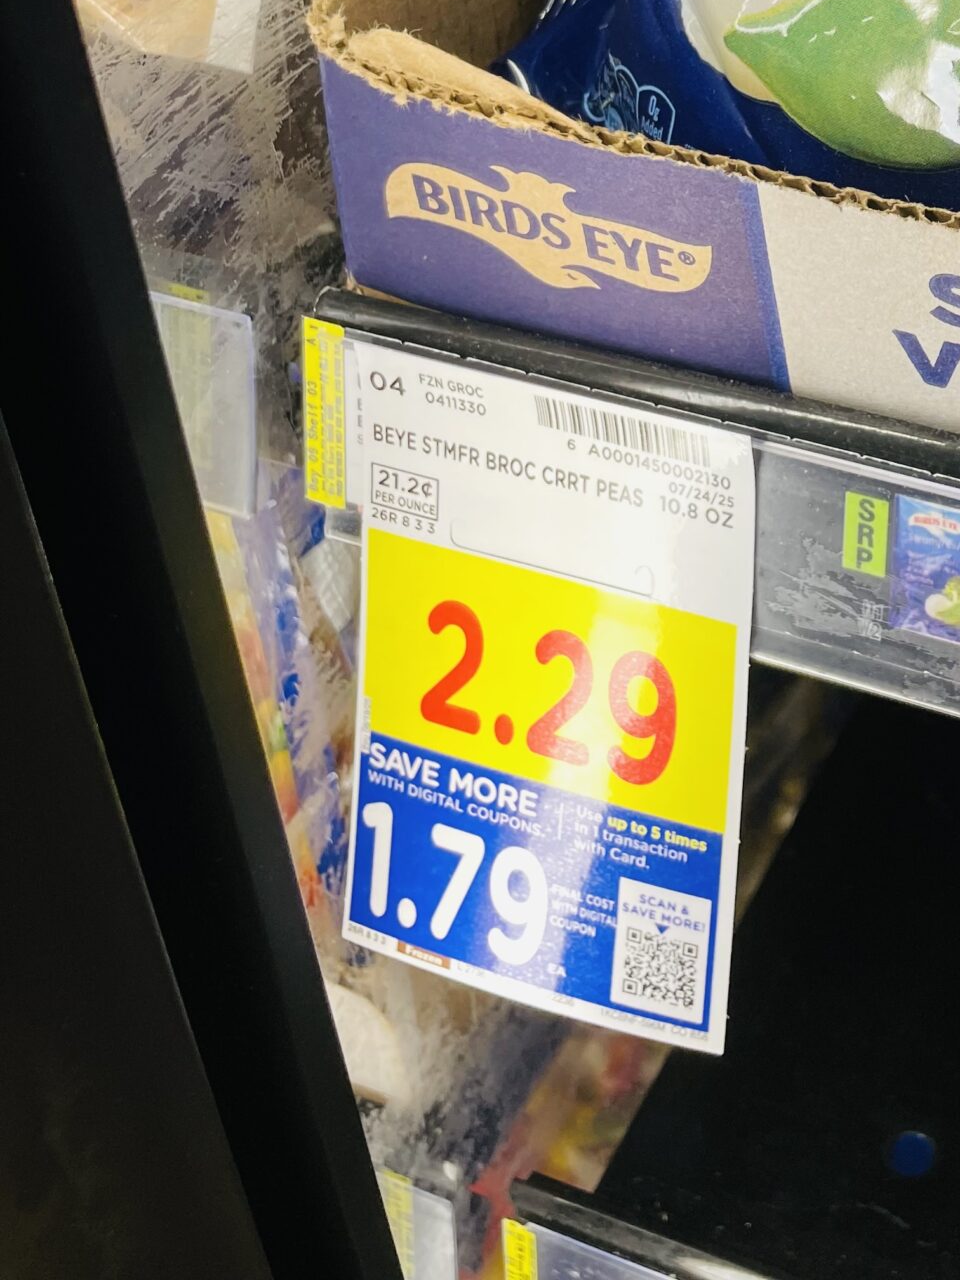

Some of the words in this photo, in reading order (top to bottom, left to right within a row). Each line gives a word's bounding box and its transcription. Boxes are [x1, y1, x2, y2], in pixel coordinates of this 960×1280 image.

[410, 173, 572, 250] BIRDS
[369, 371, 406, 396] 04
[419, 373, 444, 389] FZN
[447, 380, 484, 399] GROC
[425, 391, 487, 417] 0411330
[567, 438, 576, 451] 6
[372, 423, 417, 451] BEYE
[422, 435, 480, 467] STMFR
[486, 451, 536, 481] BROC
[542, 465, 590, 494] CRRT
[596, 479, 644, 508] PEAS
[660, 495, 698, 520] 10.8
[705, 507, 734, 529] OZ
[378, 469, 433, 498] 21.2¢
[375, 489, 395, 504] PER
[398, 496, 436, 516] OUNCE
[668, 481, 735, 508] 07/24/25
[371, 507, 398, 524] 26R
[402, 515, 410, 527] 8
[415, 519, 423, 531] 3
[427, 522, 436, 534] 3
[420, 599, 678, 786] 2.29
[368, 741, 441, 788] SAVE
[448, 767, 540, 818] MORE
[367, 769, 404, 792] WITH
[407, 780, 464, 813] DIGITAL
[467, 803, 546, 838] COUPONS.
[576, 805, 603, 823] Use
[607, 816, 627, 833] up
[630, 820, 648, 836] to
[651, 825, 661, 840] 5
[664, 829, 708, 852] times
[603, 829, 688, 862] transaction
[609, 846, 650, 869] Card.
[362, 801, 549, 966] 1.79
[586, 893, 615, 911] COST
[639, 893, 677, 913] SCAN
[681, 905, 689, 916] &
[550, 915, 597, 937] COUPON
[579, 906, 618, 928] DIGITAL
[622, 902, 657, 920] SAVE
[661, 913, 706, 933] MORE!
[548, 963, 567, 978] EA
